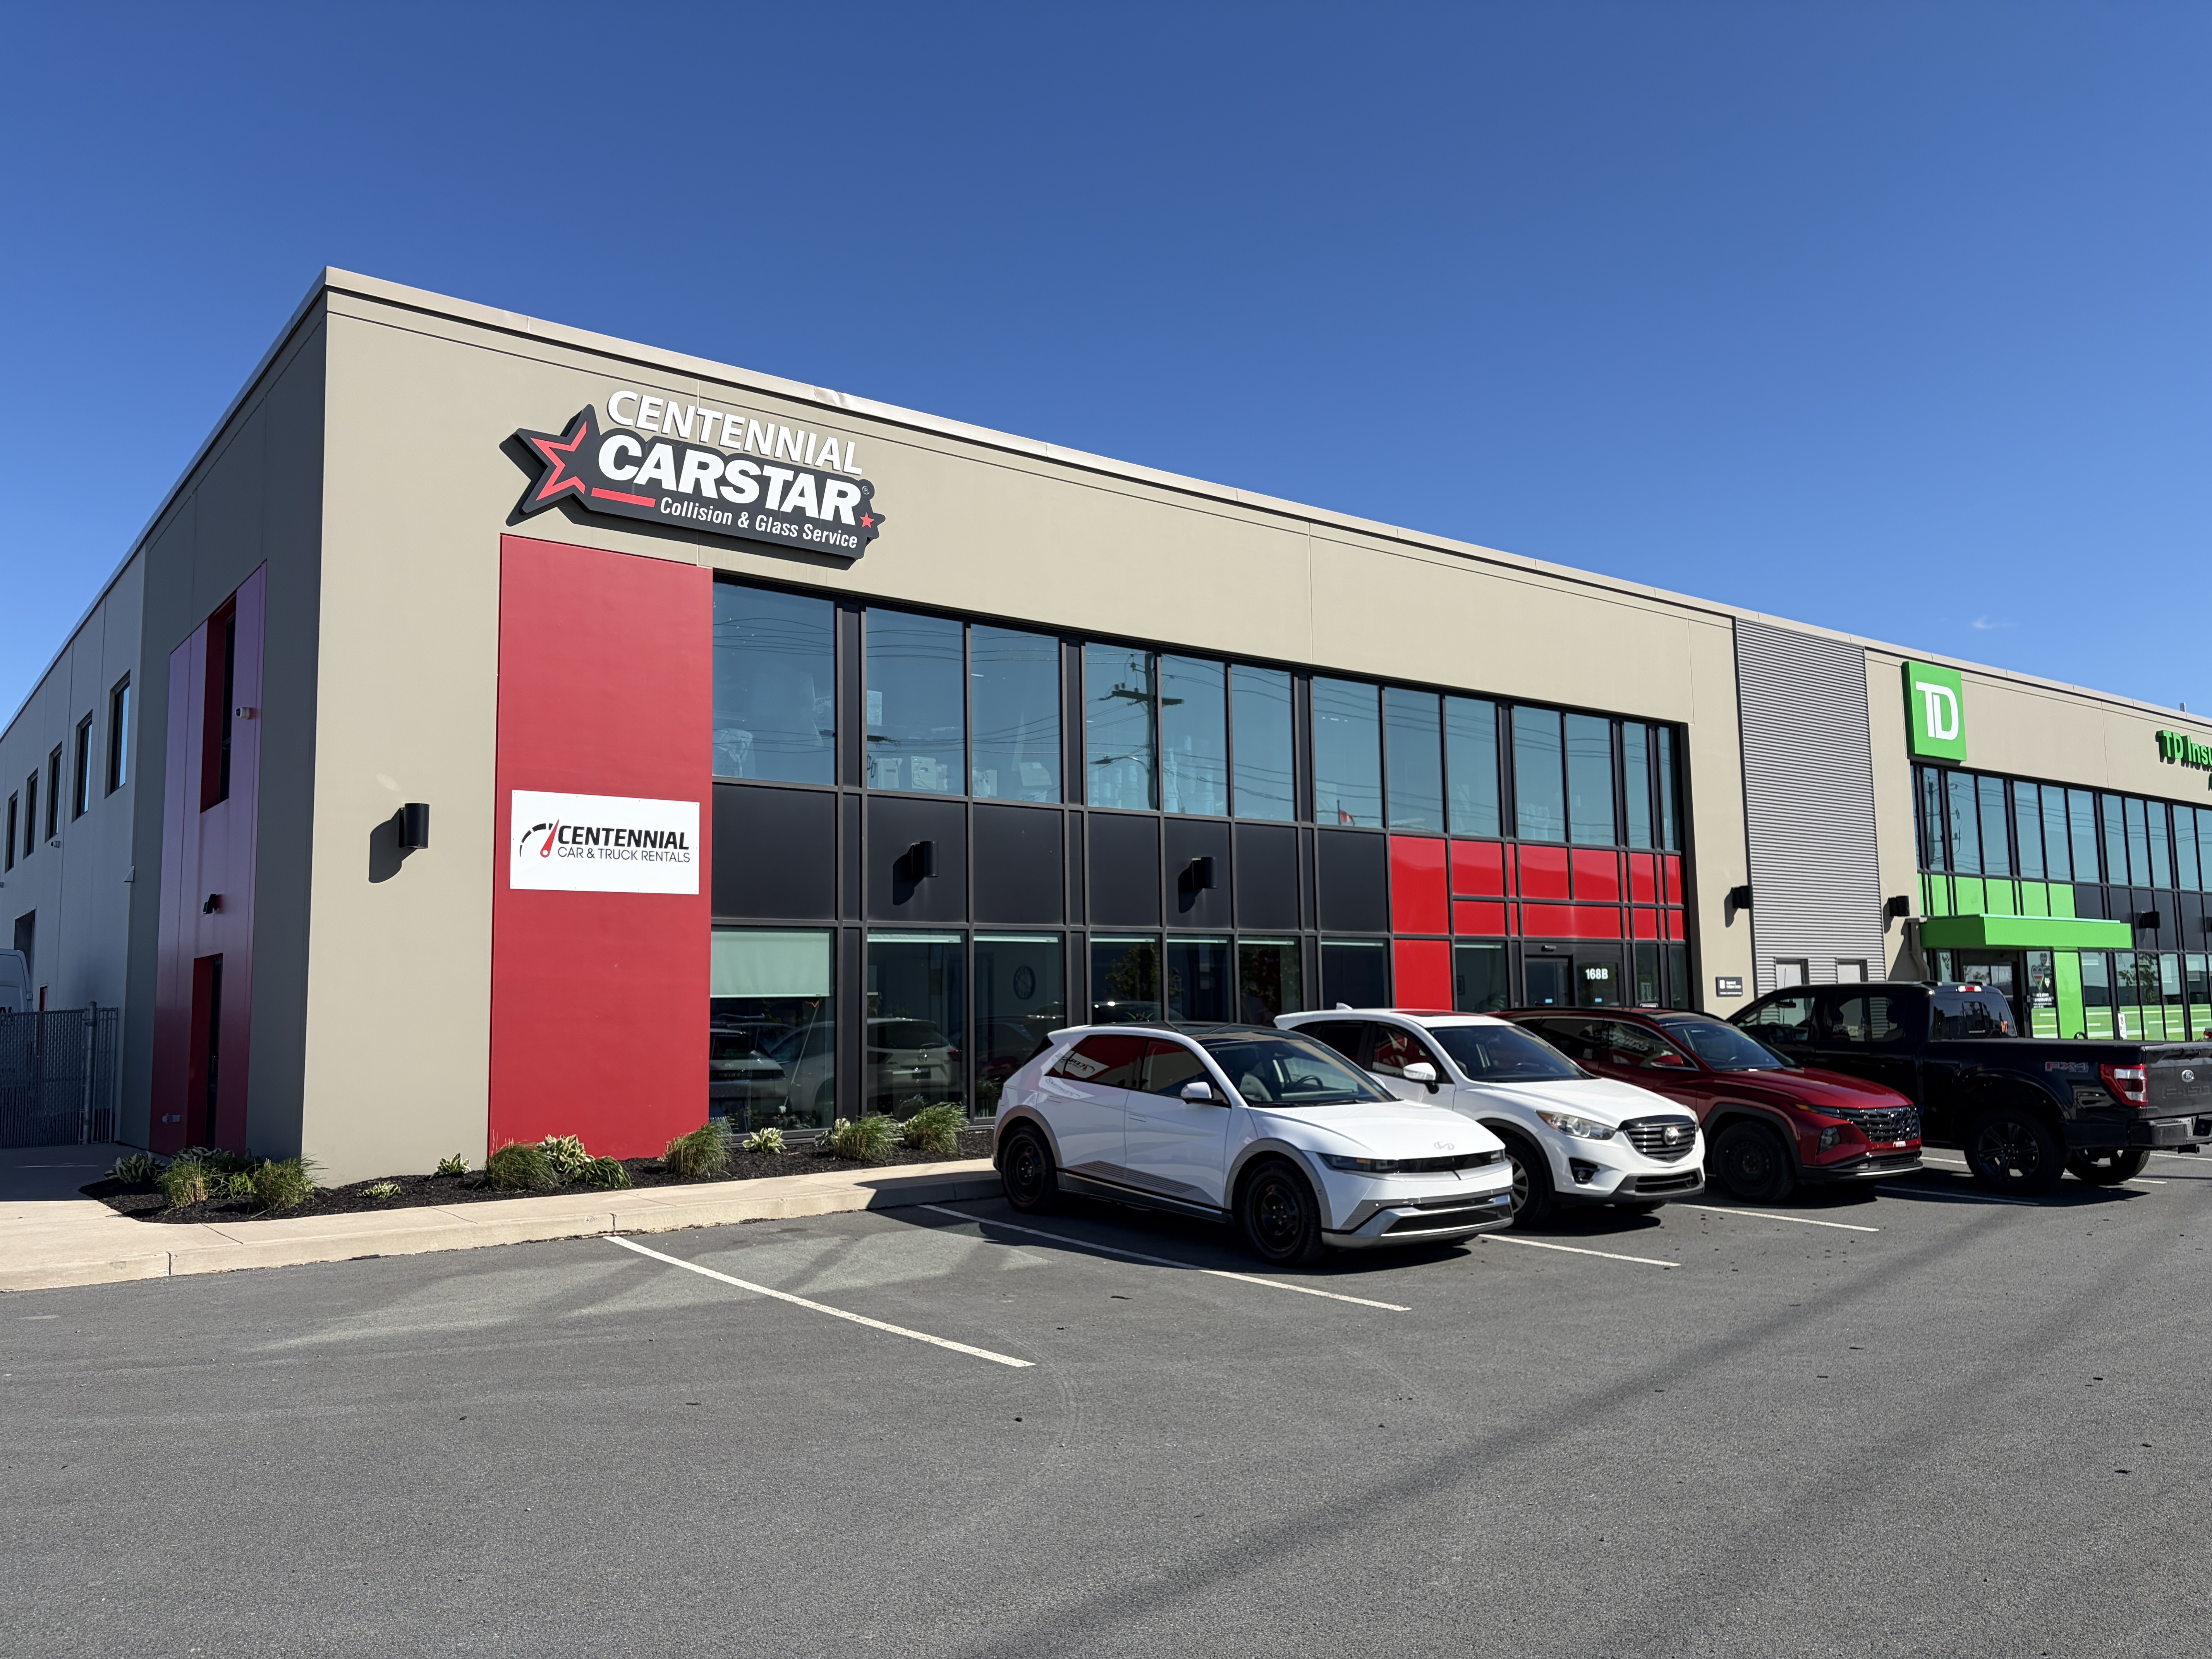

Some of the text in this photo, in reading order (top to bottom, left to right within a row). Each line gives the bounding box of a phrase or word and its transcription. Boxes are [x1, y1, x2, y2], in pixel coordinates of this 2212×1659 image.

[607, 390, 863, 476] CENTENNIAL
[659, 496, 858, 549] Collision & Glass Service
[1915, 681, 1959, 740] TD
[2162, 730, 2184, 759] TD
[558, 825, 689, 850] CENTENNIAL
[558, 847, 690, 863] CAR & TRUCK RENTALS
[1585, 968, 1608, 980] 168B
[2045, 1061, 2089, 1073] FX4
